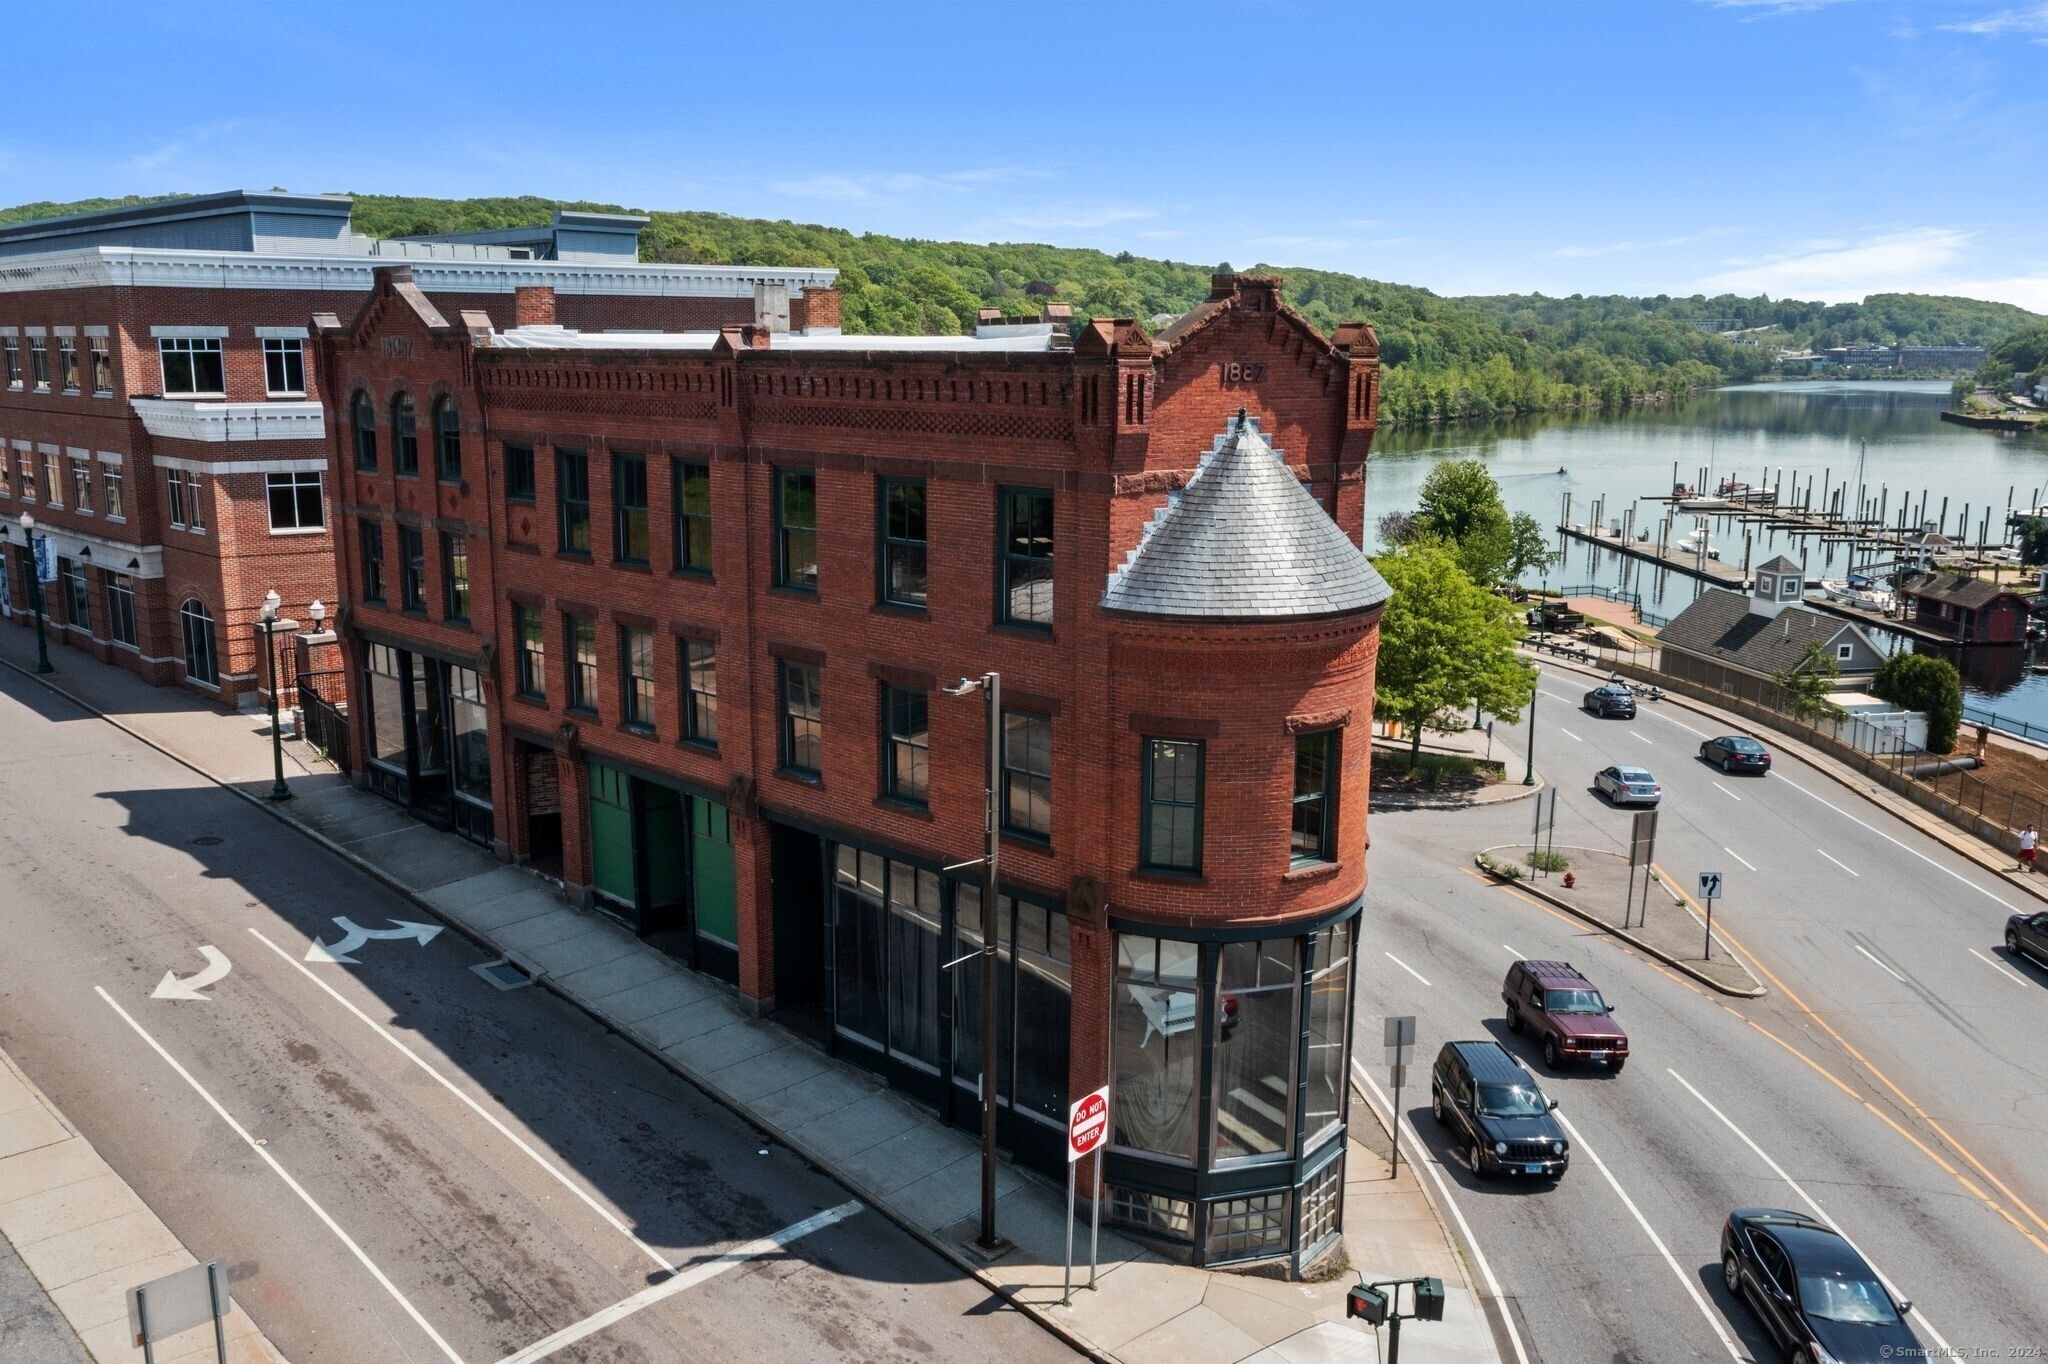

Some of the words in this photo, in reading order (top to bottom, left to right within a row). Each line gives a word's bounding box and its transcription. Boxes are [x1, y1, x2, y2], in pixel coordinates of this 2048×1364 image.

[1223, 362, 1264, 382] 1887
[1076, 1109, 1086, 1123] DO
[1089, 1099, 1104, 1116] NOT
[1077, 1126, 1100, 1147] ENTER
